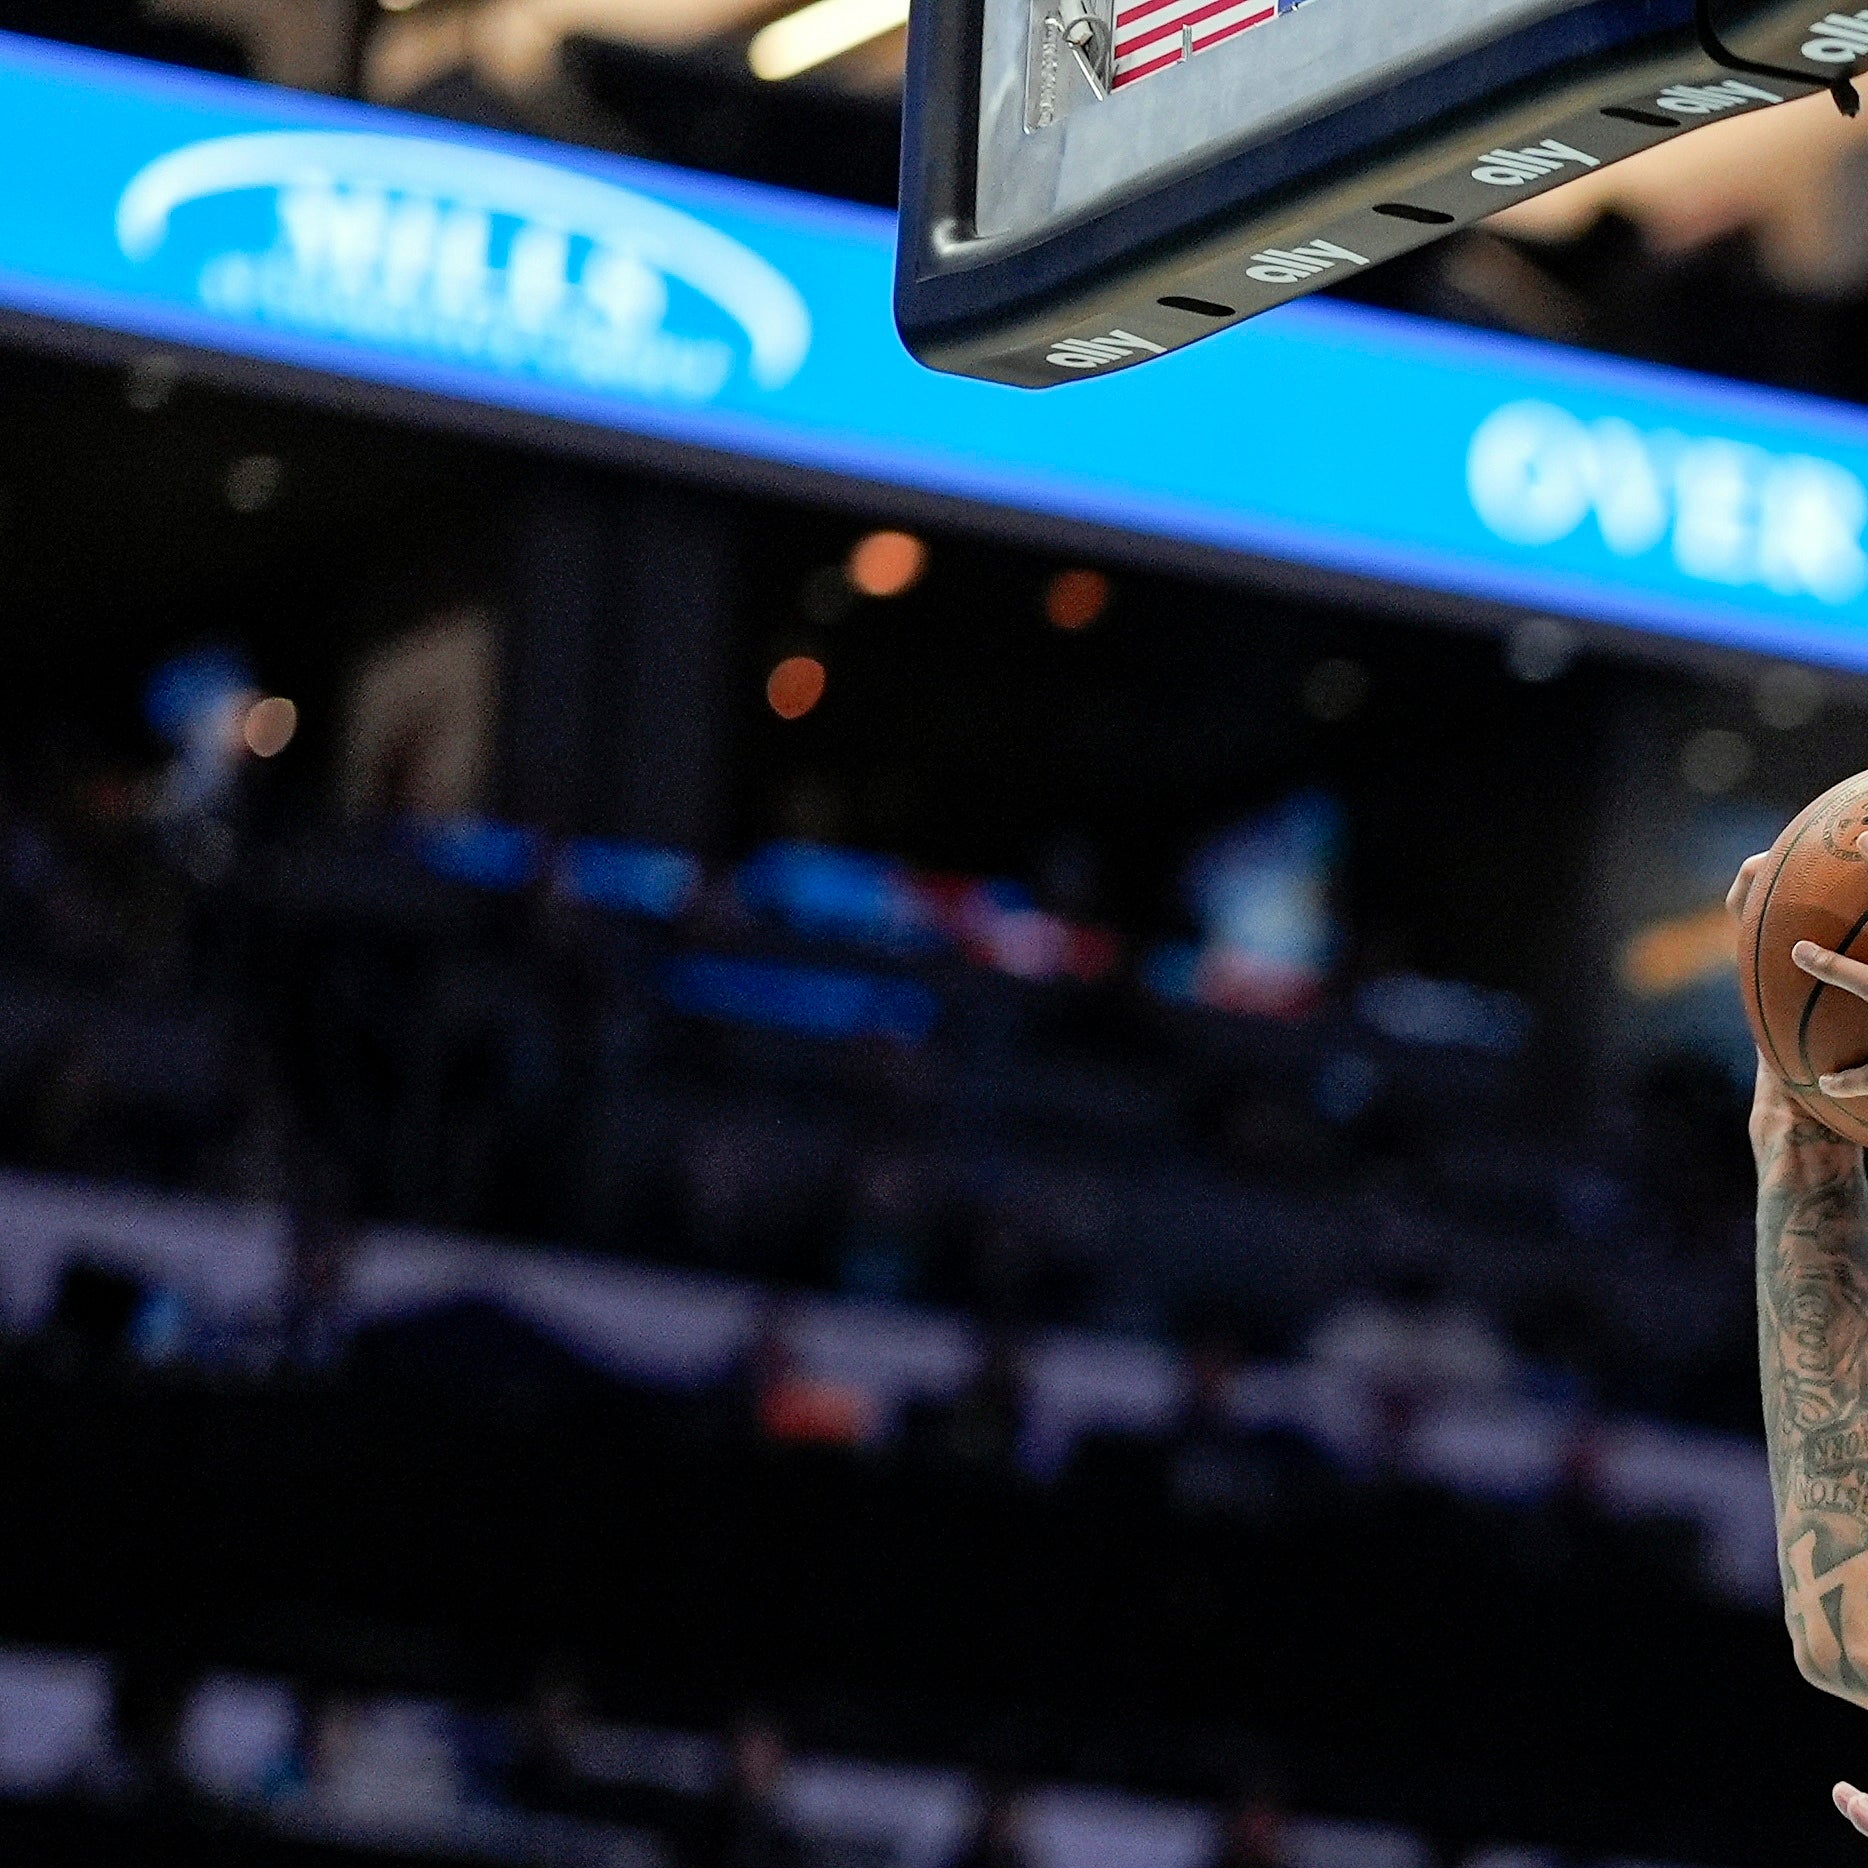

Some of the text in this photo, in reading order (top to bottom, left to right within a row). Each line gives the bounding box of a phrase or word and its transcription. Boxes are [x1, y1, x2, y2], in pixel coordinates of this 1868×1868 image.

[1471, 138, 1600, 187] ally
[1246, 239, 1370, 284] ally
[1046, 329, 1168, 369] ally
